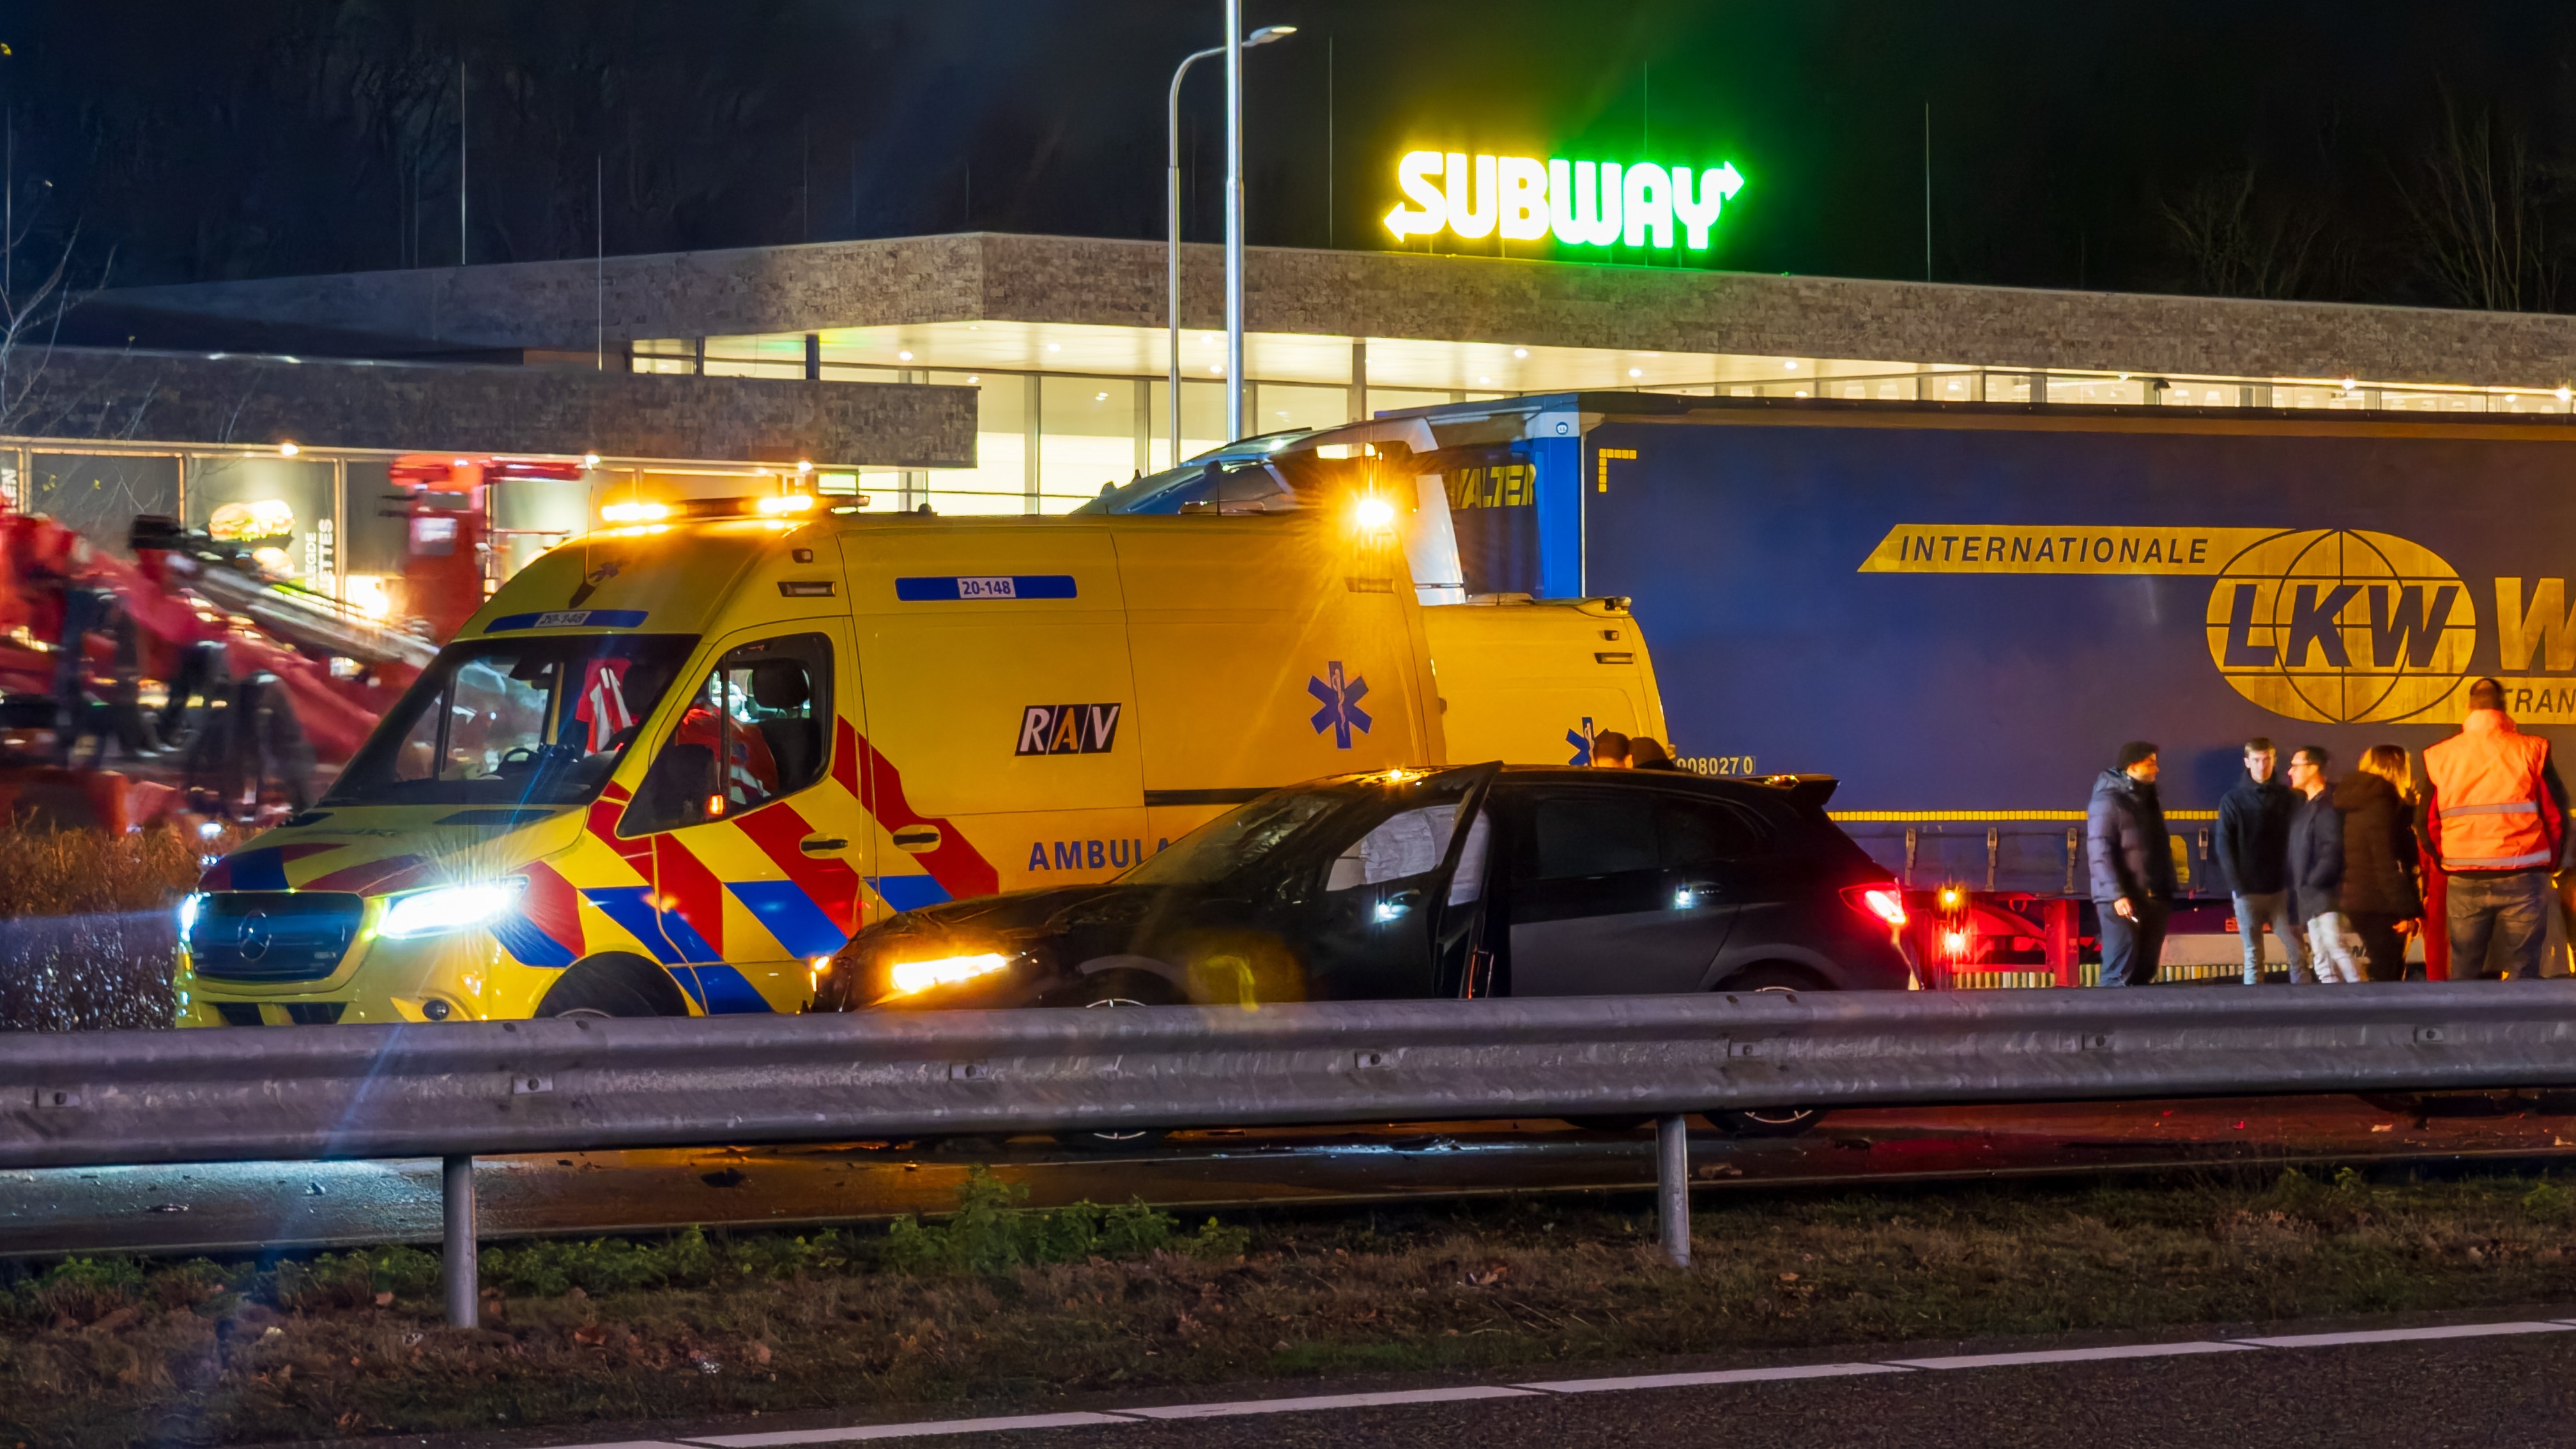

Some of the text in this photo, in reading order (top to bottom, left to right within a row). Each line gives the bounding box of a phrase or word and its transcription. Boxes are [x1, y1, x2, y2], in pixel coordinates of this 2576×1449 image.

[1383, 151, 1744, 250] SUBWAY
[305, 532, 317, 590] ELEGDE
[1901, 535, 2208, 564] INTERNATIONALE
[962, 581, 1011, 595] 20-148
[2223, 584, 2460, 667] LKW
[1020, 706, 1119, 751] RAV
